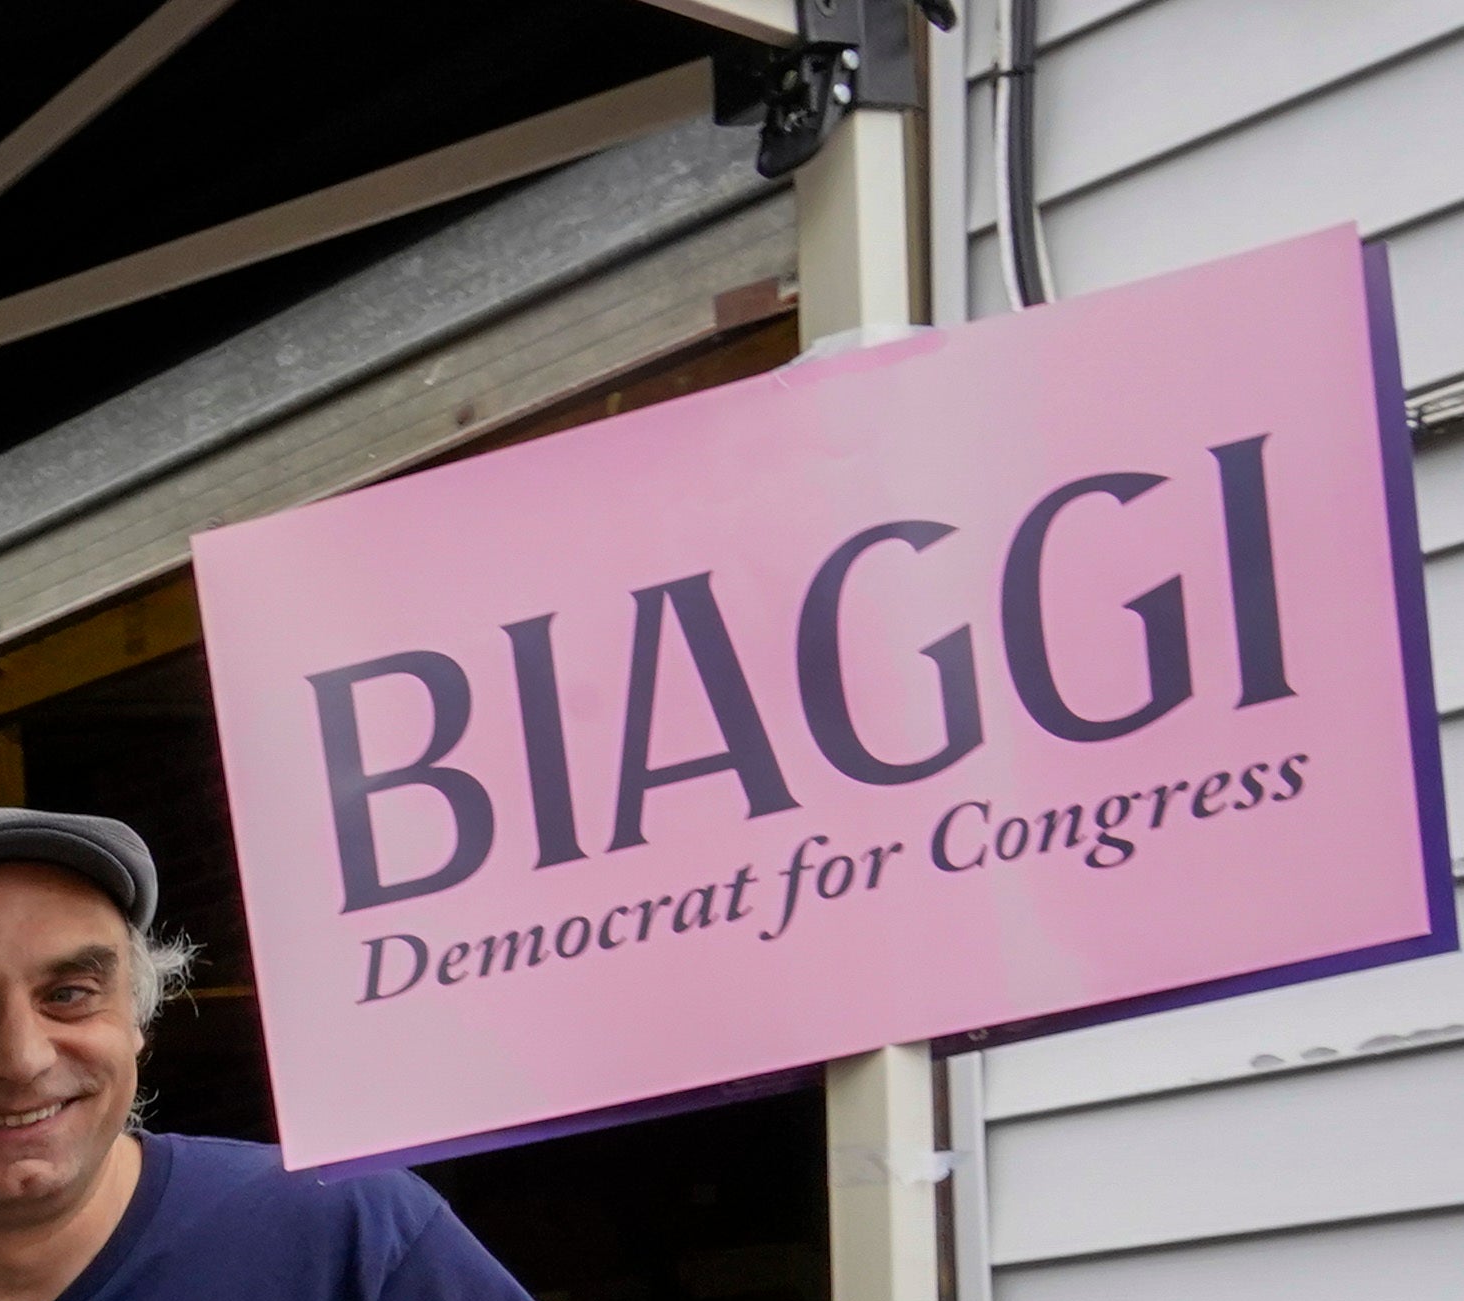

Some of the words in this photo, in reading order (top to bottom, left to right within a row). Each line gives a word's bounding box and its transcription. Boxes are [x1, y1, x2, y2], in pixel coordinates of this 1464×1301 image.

[305, 432, 1298, 915] BIAGGI
[356, 865, 757, 1004] Democrat
[757, 834, 903, 941] for
[931, 753, 1311, 870] Congress
